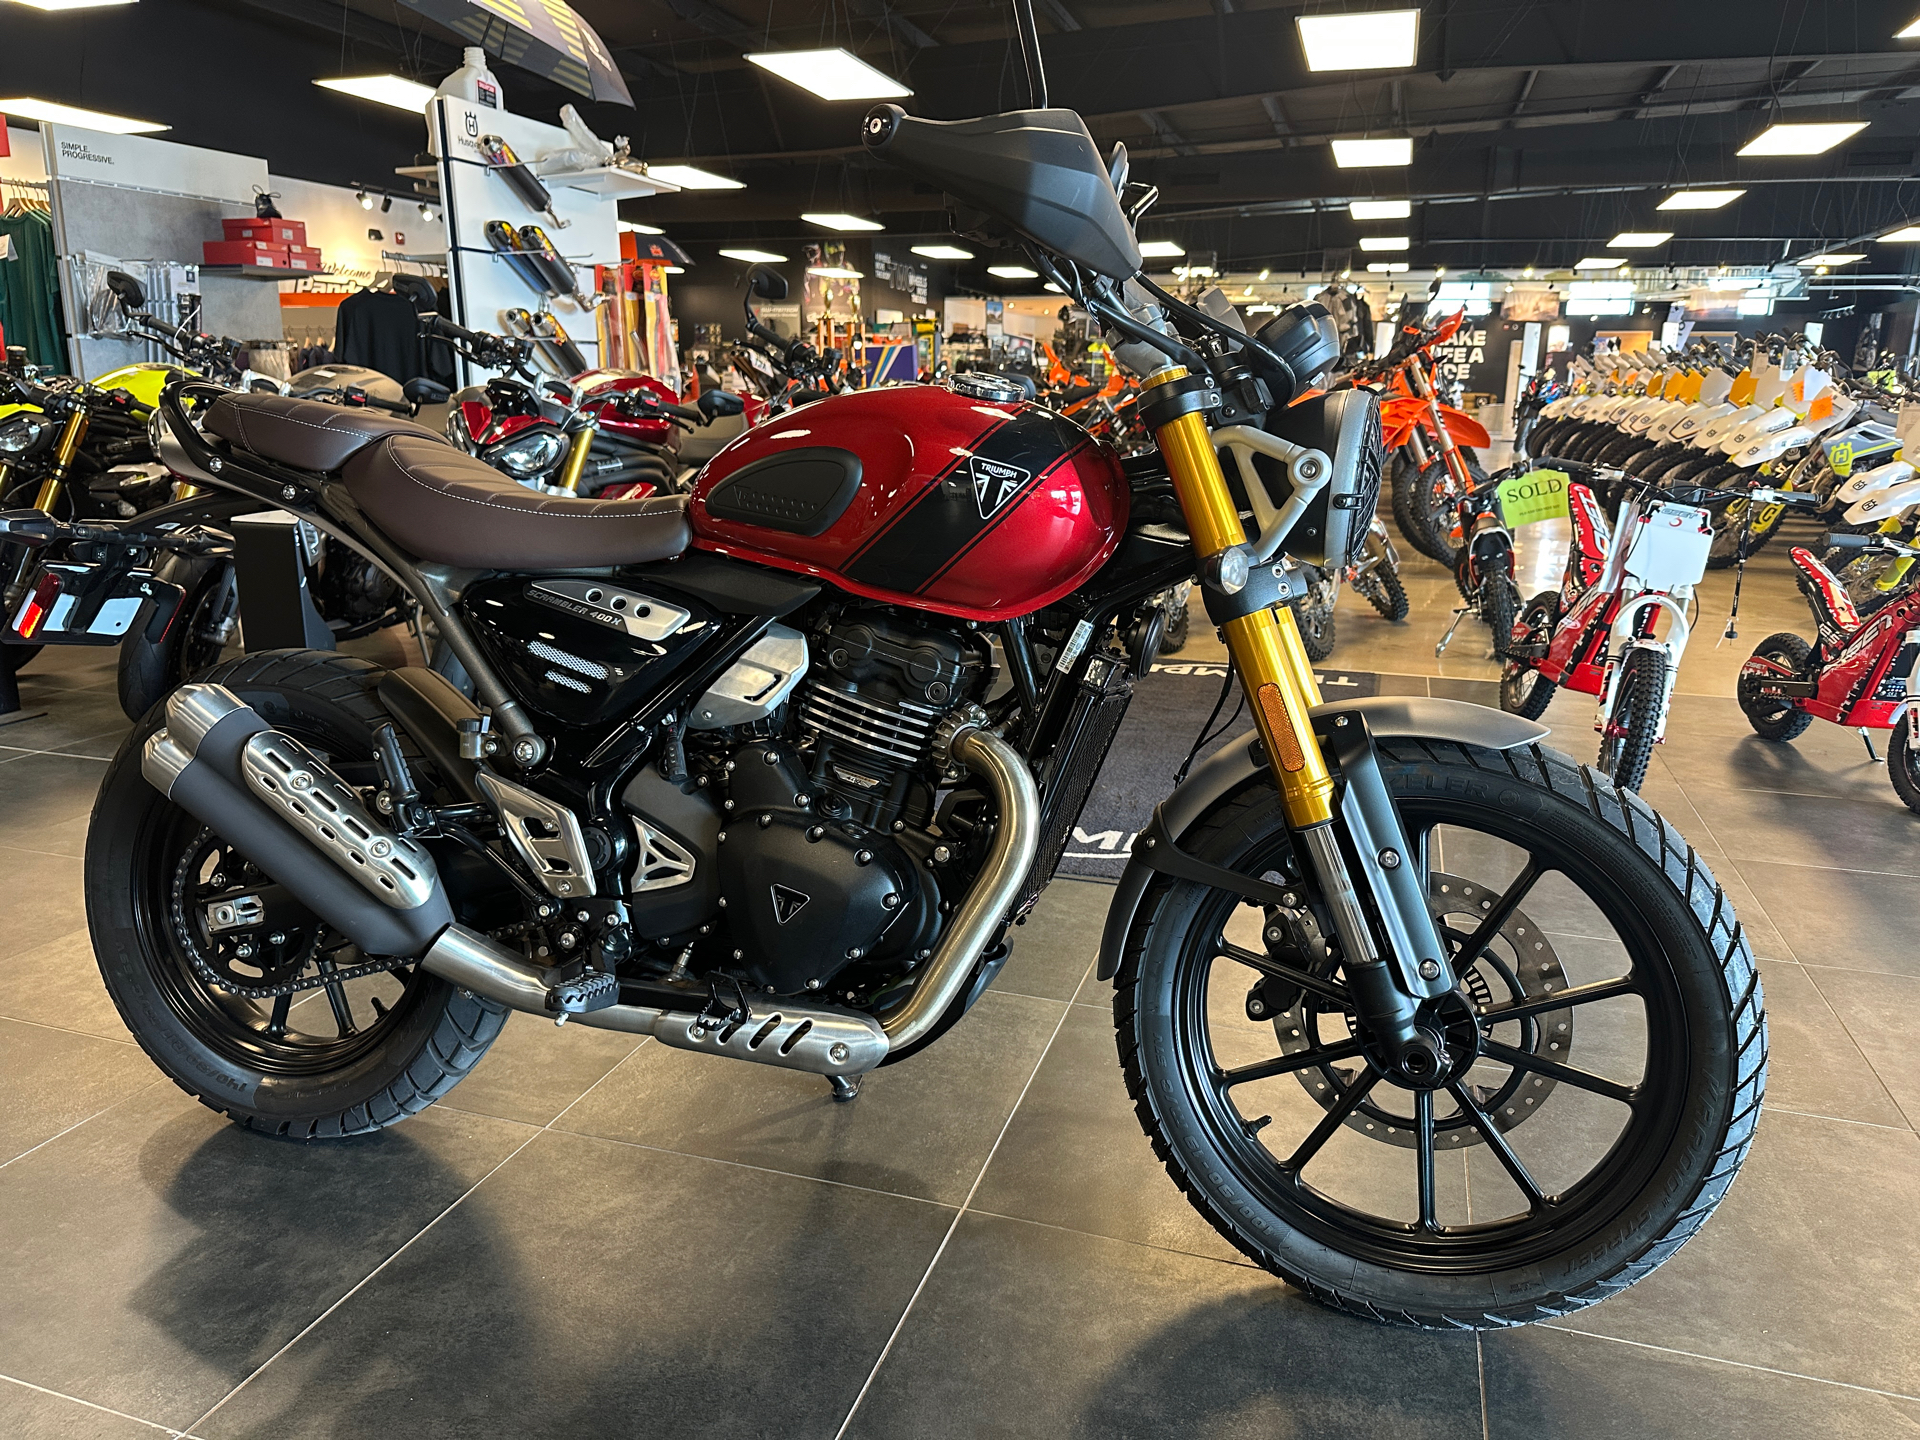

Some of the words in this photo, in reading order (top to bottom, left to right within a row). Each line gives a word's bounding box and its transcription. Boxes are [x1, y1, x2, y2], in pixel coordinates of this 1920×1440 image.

[61, 142, 90, 153] SIMPLE.
[62, 150, 115, 165] PROGRESSIVE.
[321, 263, 372, 280] Welcome
[1439, 330, 1487, 346] AKE
[1468, 347, 1484, 363] A
[981, 462, 1018, 479] TRIUMPH
[1506, 478, 1562, 503] SOLD
[527, 589, 589, 615] SCRAMBLER
[1563, 1203, 1653, 1277] STREET
